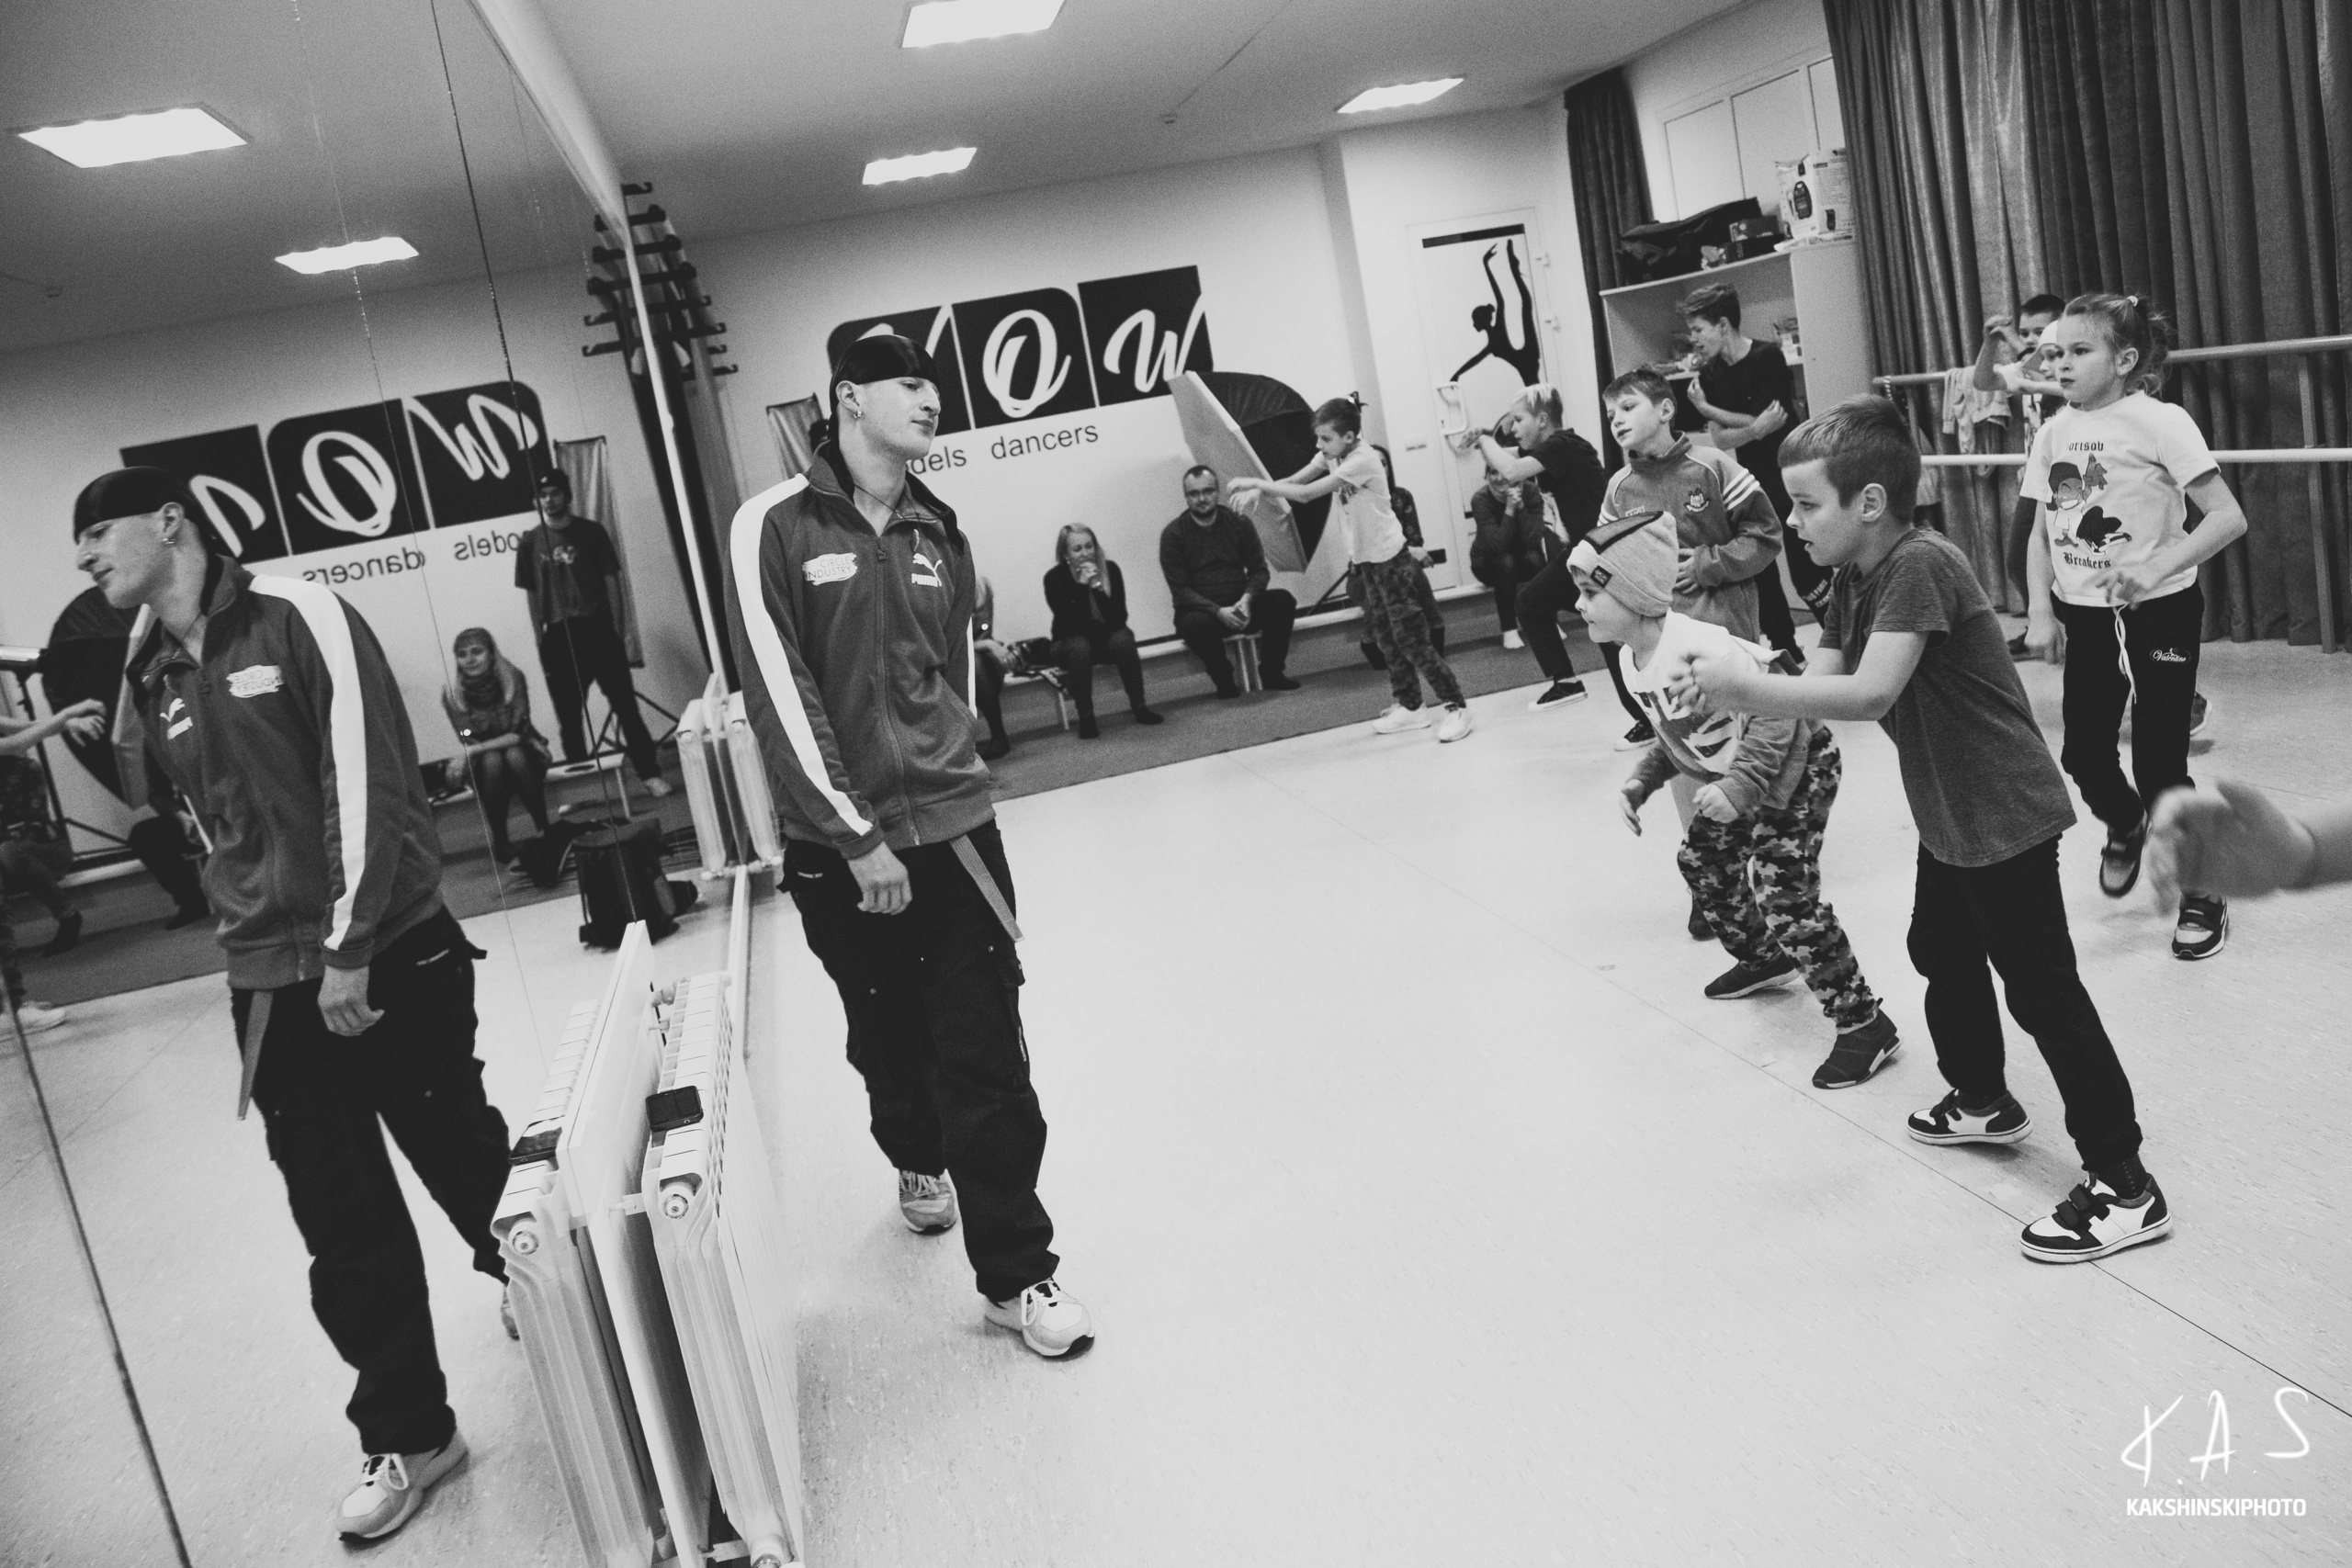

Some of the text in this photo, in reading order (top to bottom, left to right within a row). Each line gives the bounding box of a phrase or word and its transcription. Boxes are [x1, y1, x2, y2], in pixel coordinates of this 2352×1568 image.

[991, 424, 1099, 459] dancers
[820, 556, 851, 569] CIRCLE
[2064, 551, 2111, 569] Breakers
